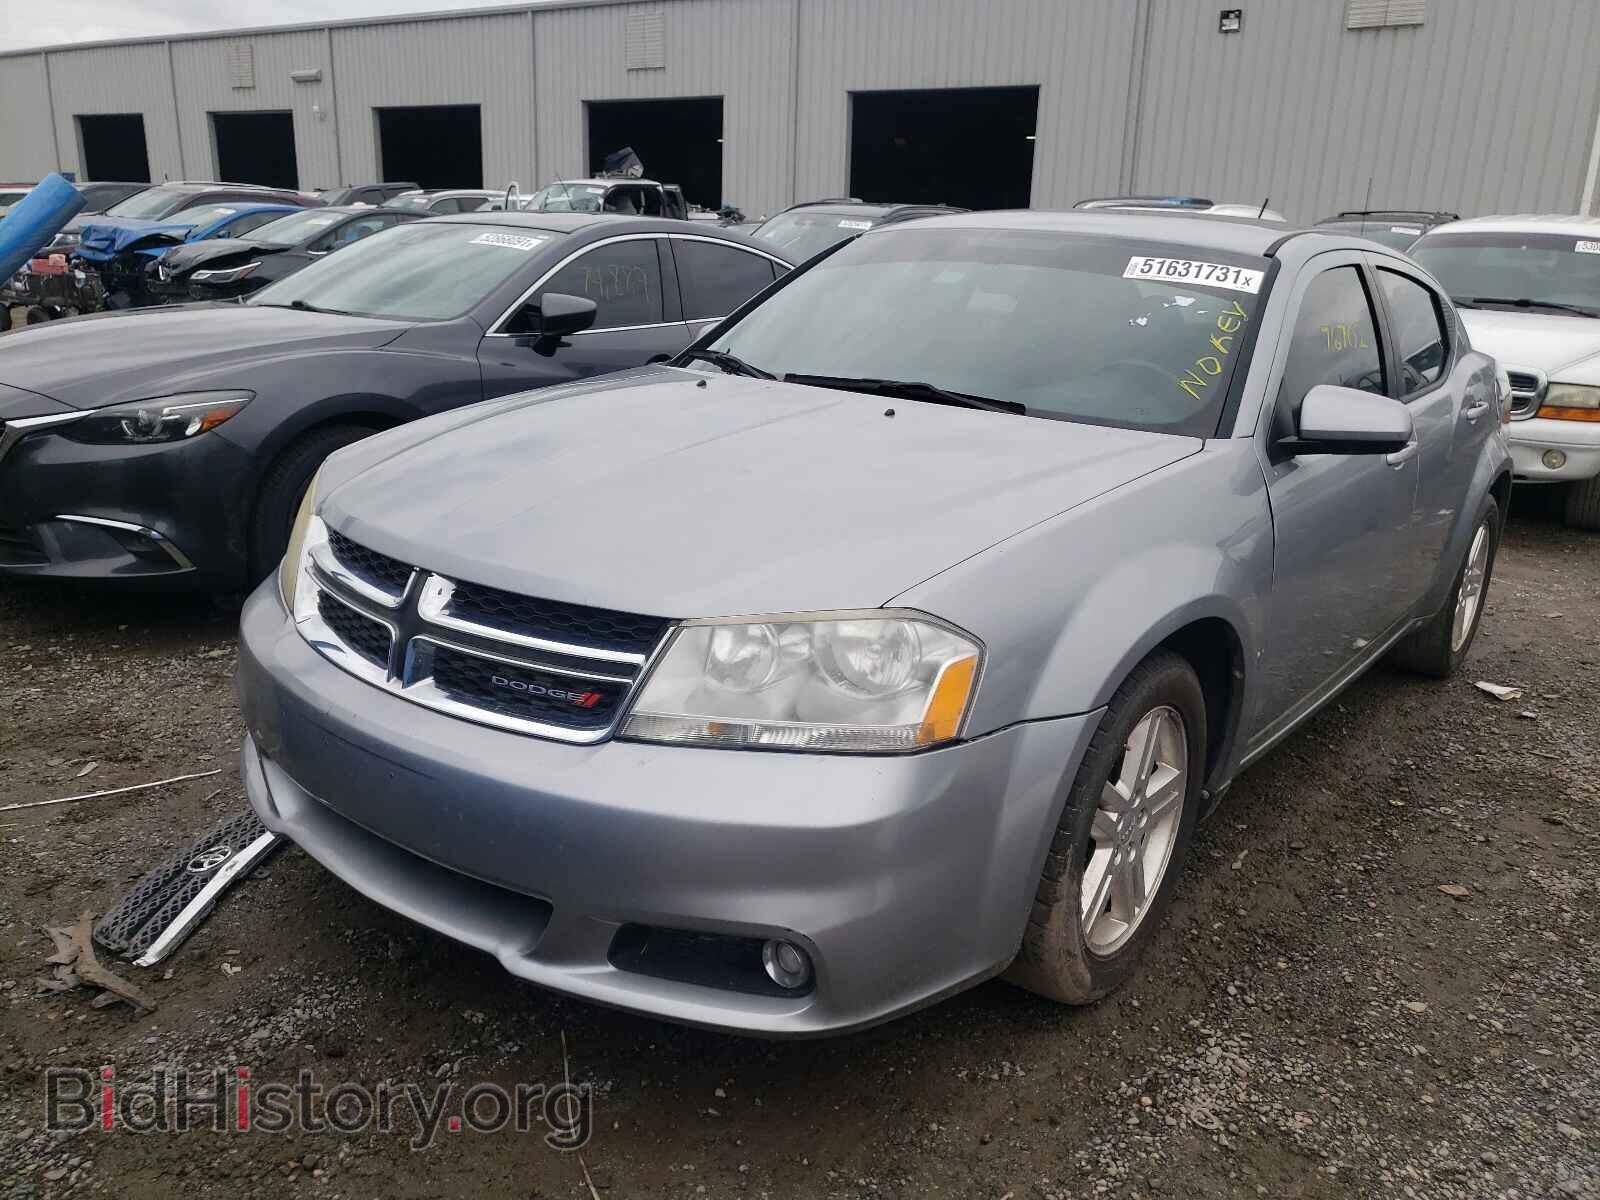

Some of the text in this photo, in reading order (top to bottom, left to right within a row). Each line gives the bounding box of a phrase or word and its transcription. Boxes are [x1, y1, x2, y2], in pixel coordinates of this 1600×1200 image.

[1177, 301, 1248, 400] NO KEY
[492, 675, 585, 702] DODGE
